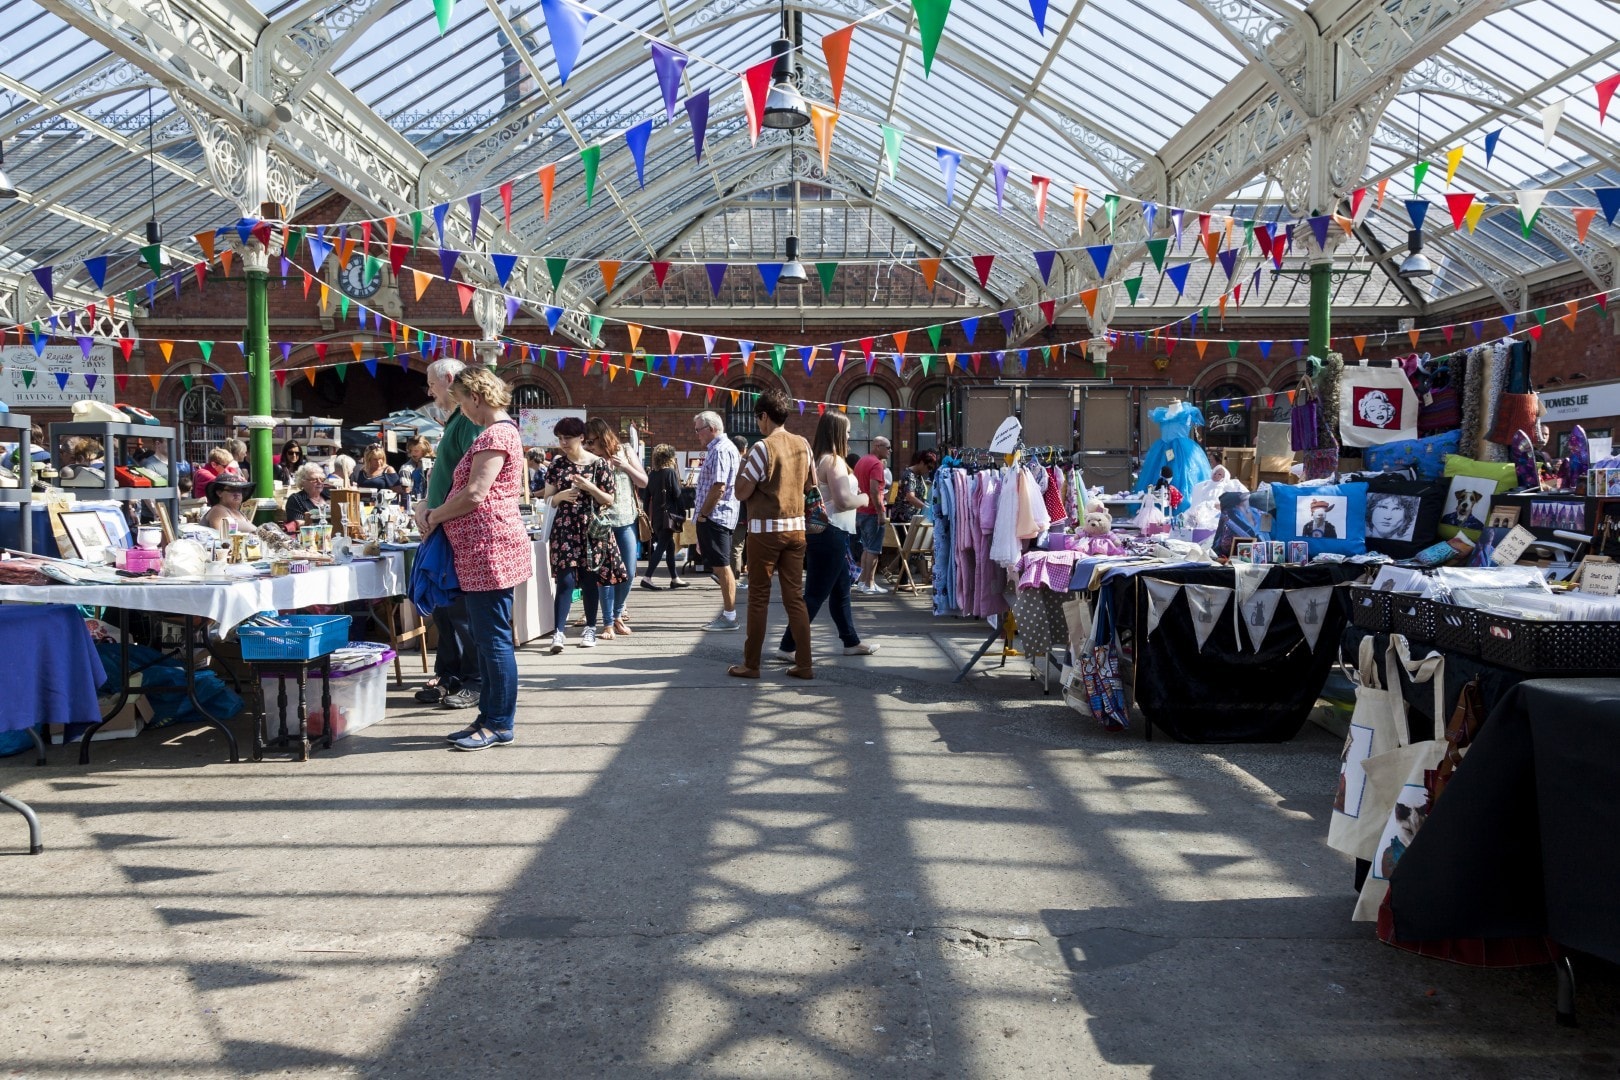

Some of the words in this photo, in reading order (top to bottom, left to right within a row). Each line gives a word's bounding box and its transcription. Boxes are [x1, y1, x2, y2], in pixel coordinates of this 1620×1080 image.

[16, 393, 54, 401] HAVING
[58, 393, 64, 401] A
[68, 393, 104, 401] PARTY?
[1544, 396, 1575, 409] TOWERS
[1577, 395, 1588, 405] LEE
